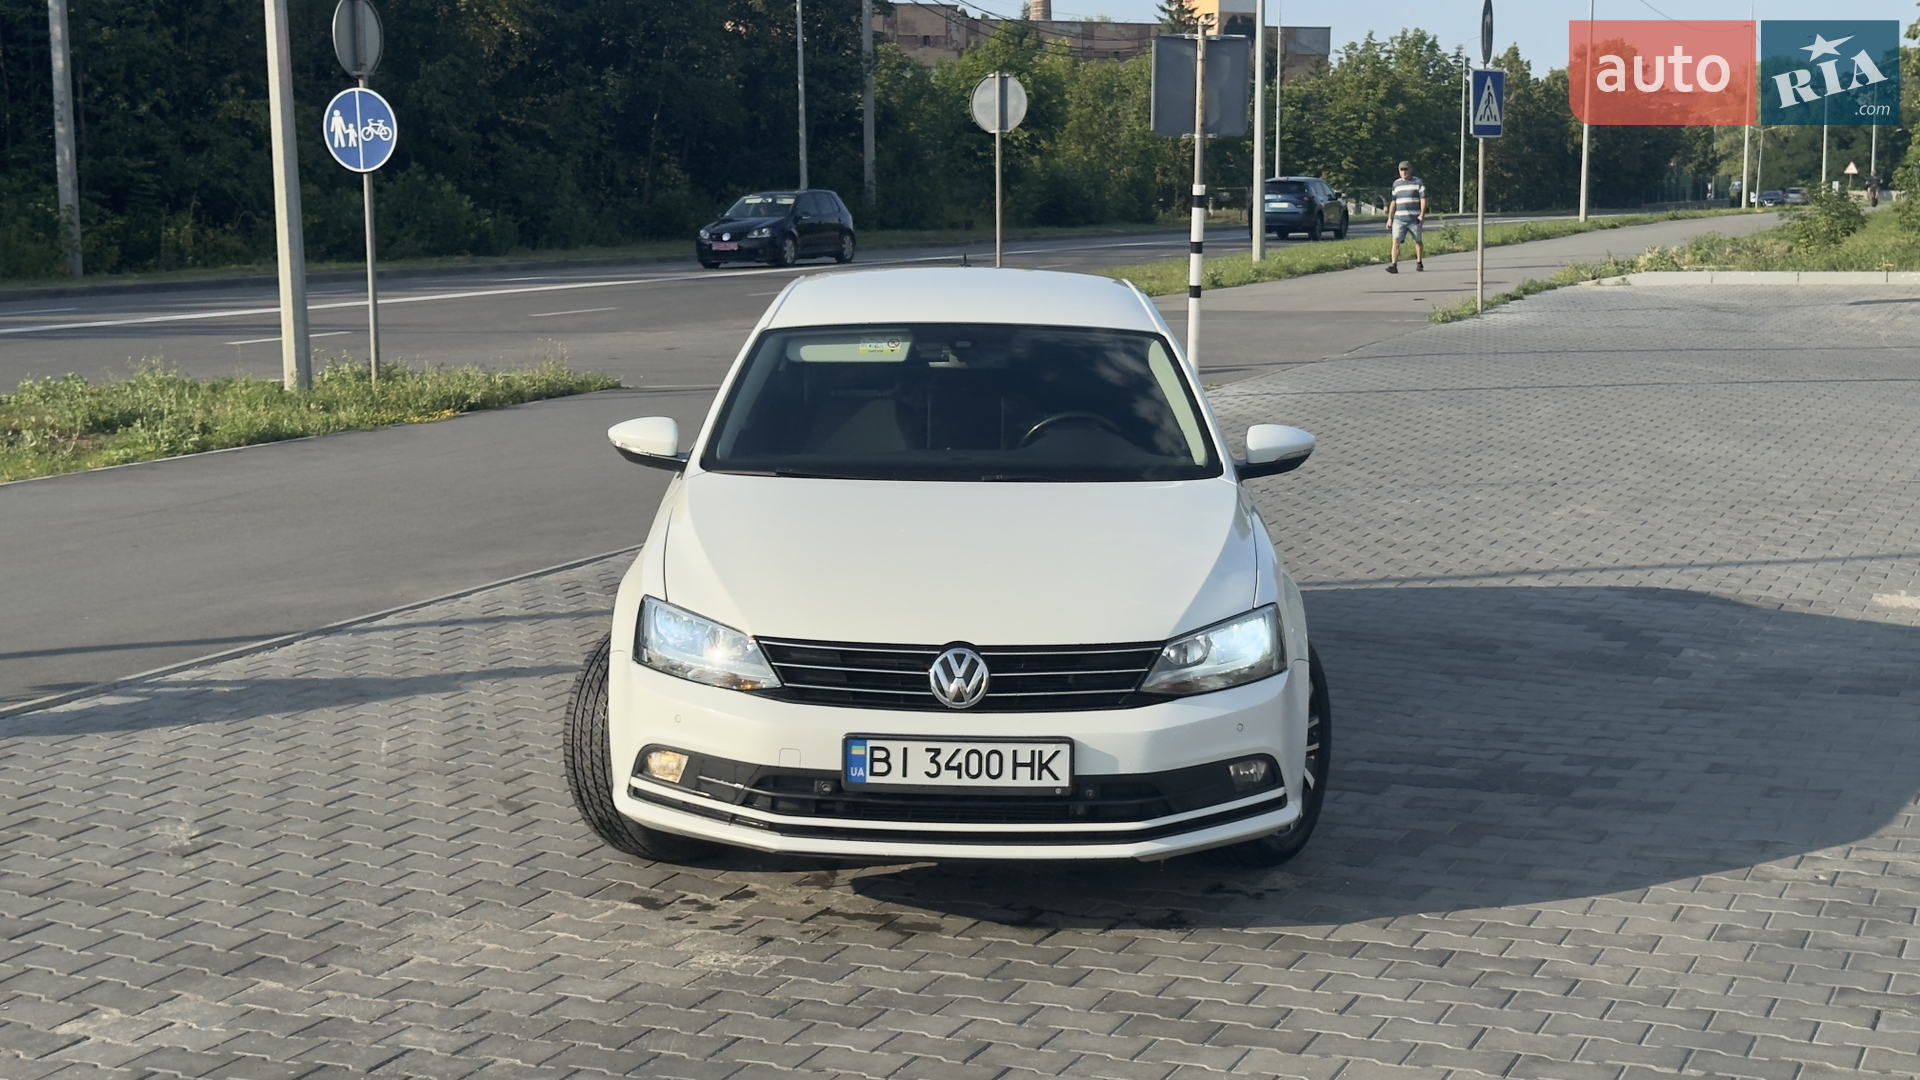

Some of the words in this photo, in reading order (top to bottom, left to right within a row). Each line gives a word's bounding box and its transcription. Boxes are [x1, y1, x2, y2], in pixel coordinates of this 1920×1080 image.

[850, 767, 865, 777] UA
[868, 746, 908, 778] BI
[924, 747, 1003, 780] 3400
[1012, 749, 1061, 781] HK
